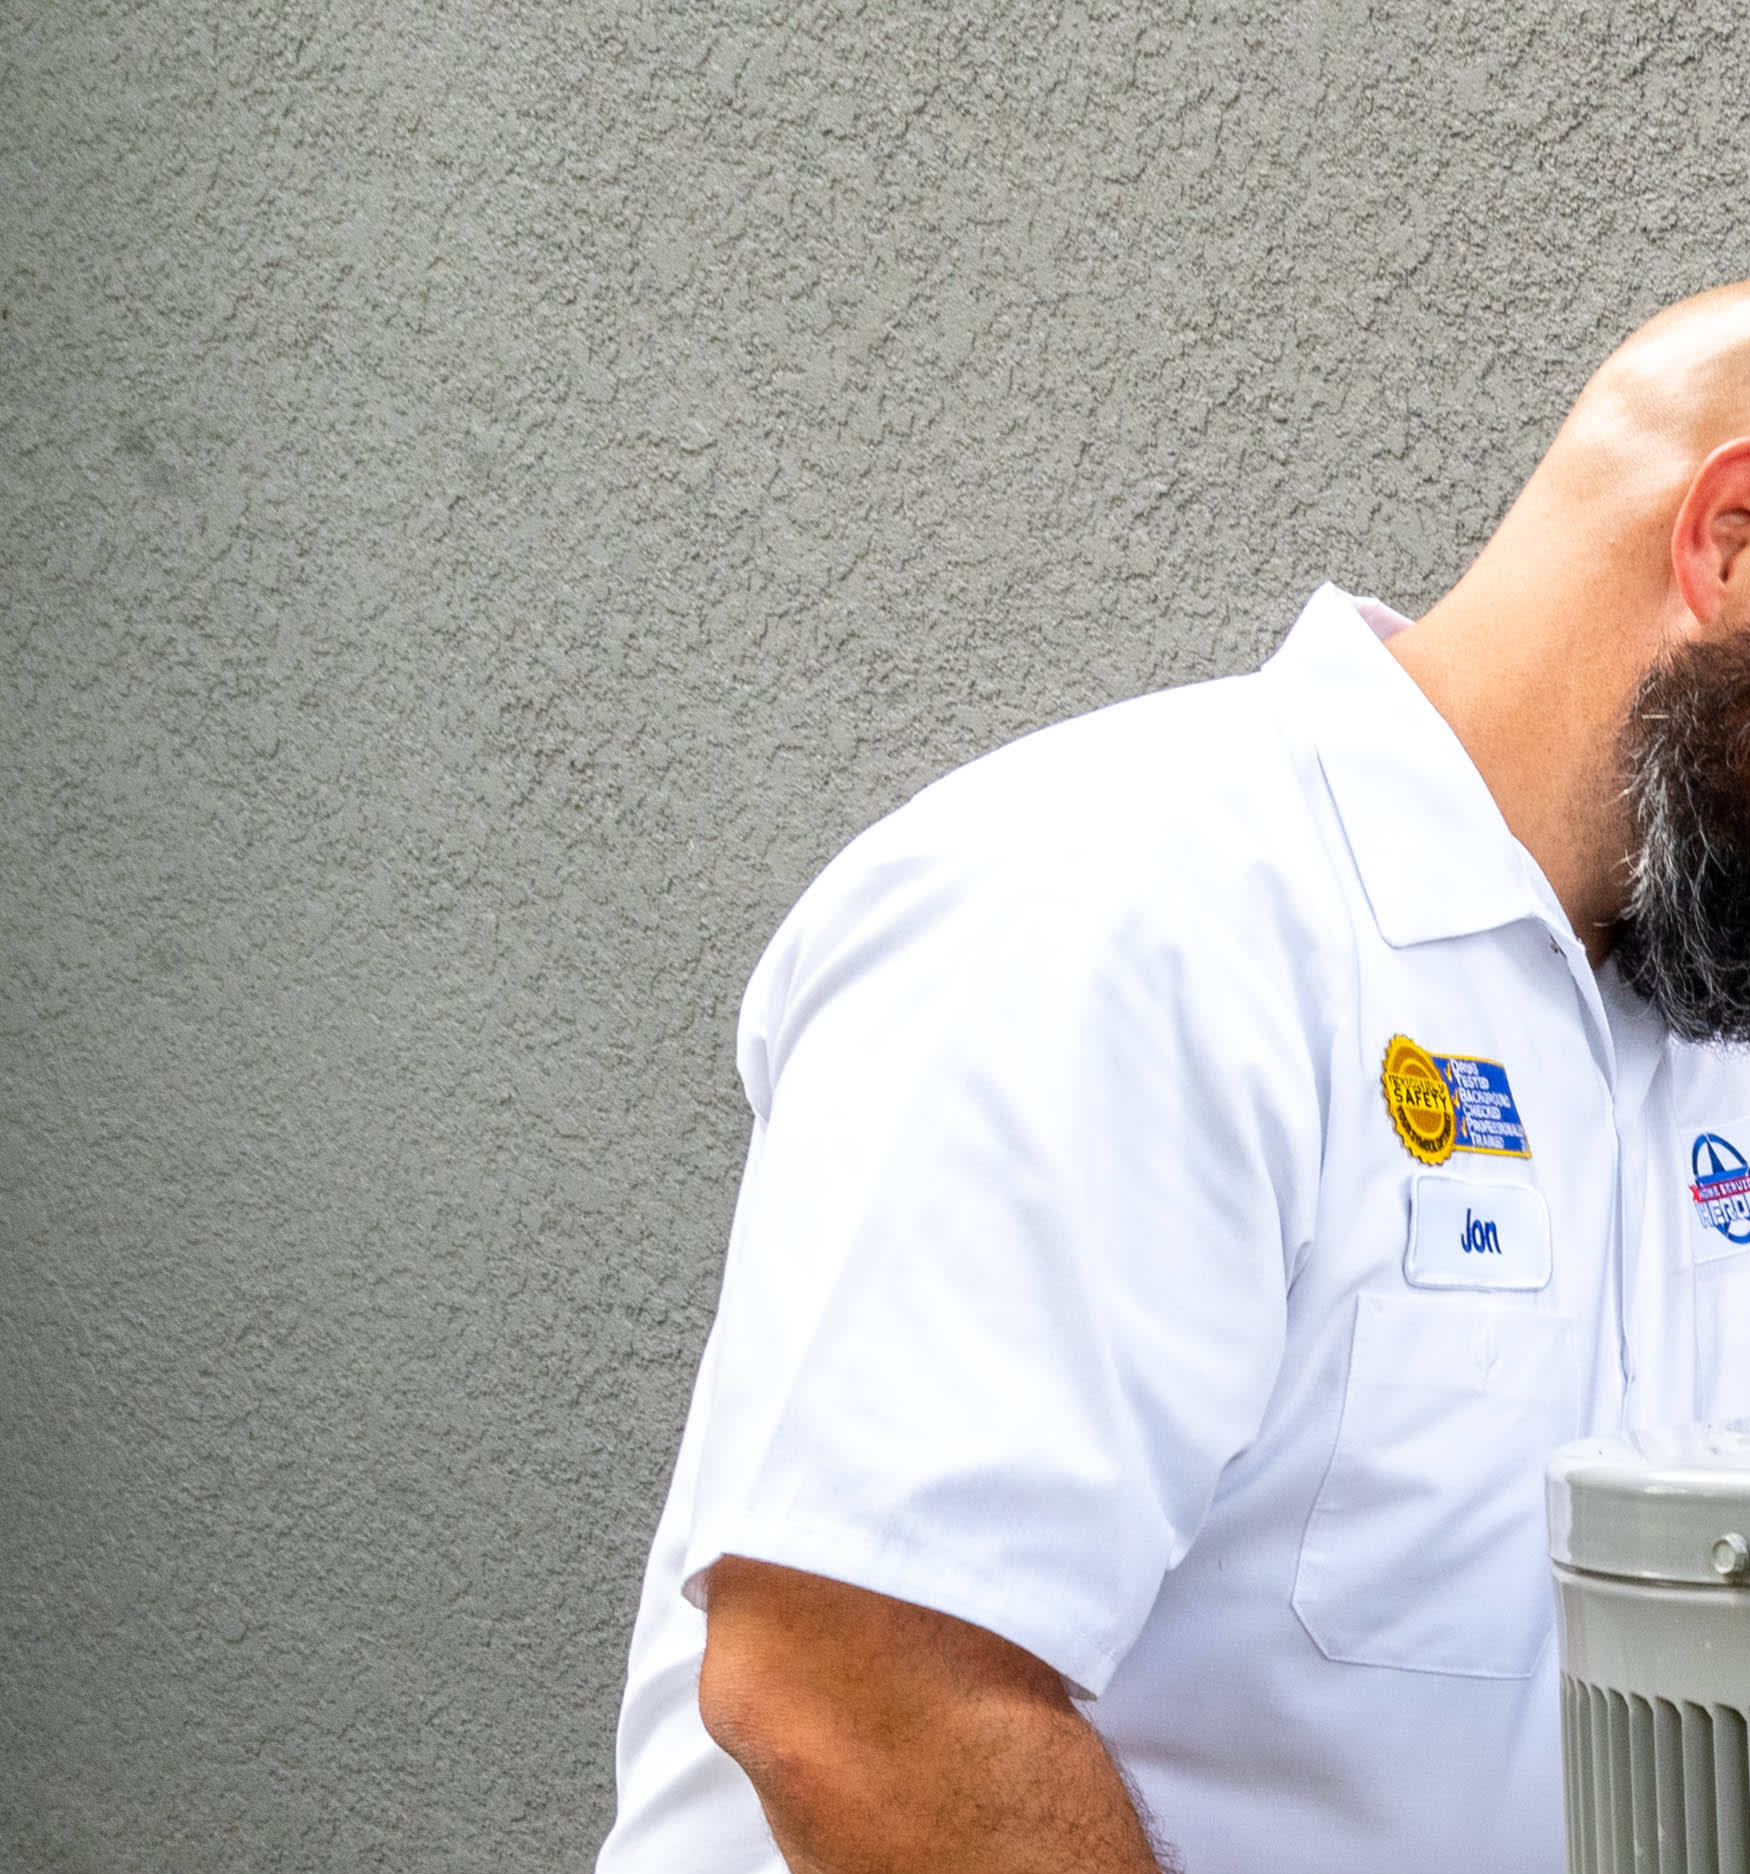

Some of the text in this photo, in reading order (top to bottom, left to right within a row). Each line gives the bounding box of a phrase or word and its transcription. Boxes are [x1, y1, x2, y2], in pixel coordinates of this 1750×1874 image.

[1455, 1073, 1490, 1090] TESTED
[1393, 1087, 1447, 1111] SAFETY
[1460, 1208, 1503, 1255] Jon
